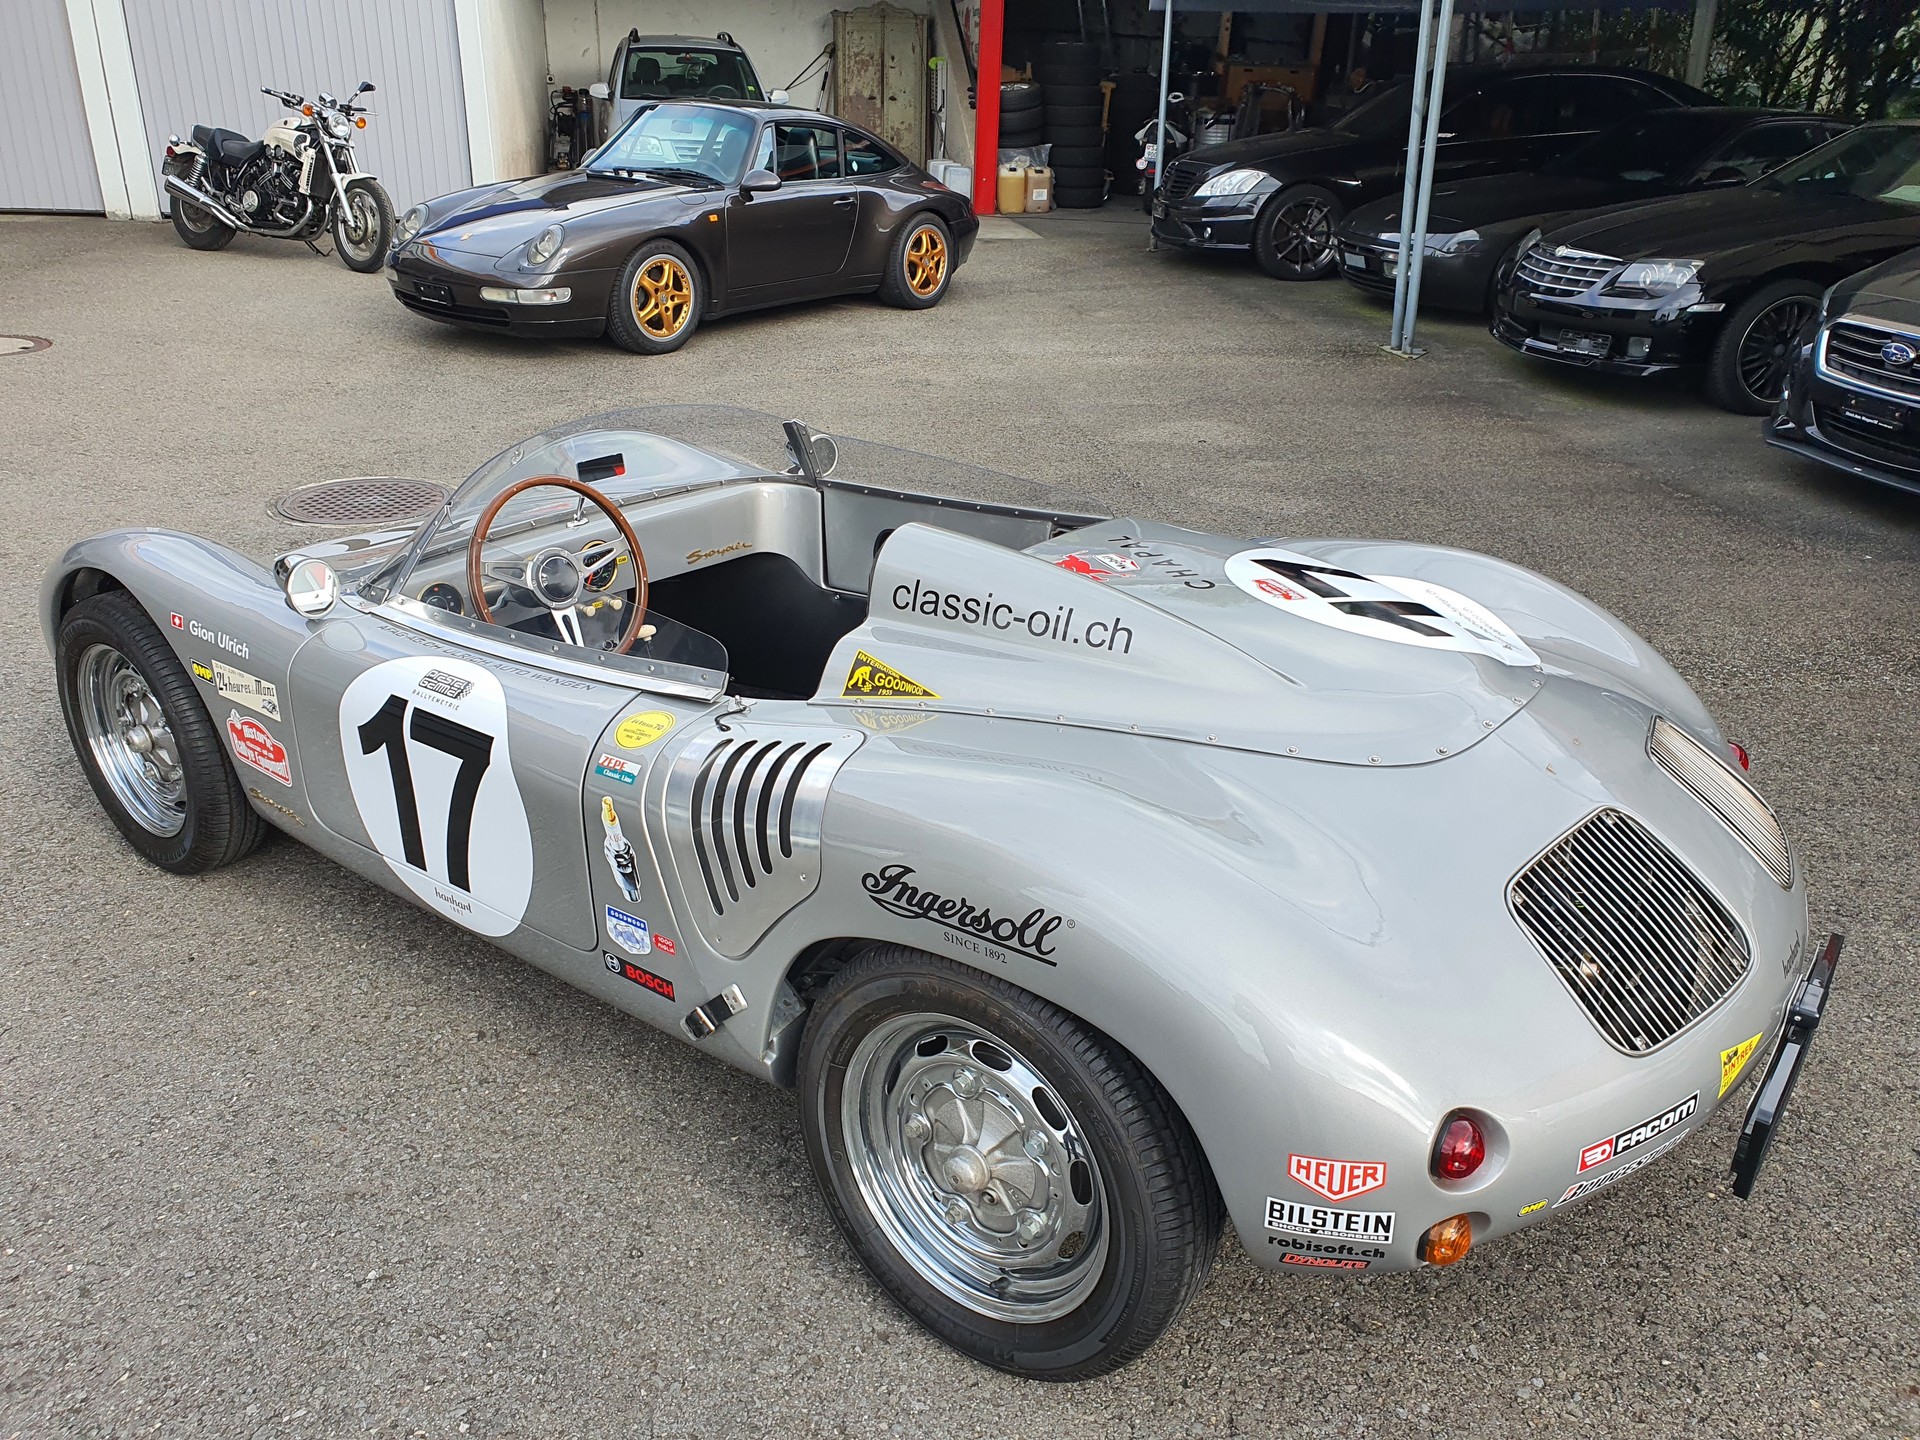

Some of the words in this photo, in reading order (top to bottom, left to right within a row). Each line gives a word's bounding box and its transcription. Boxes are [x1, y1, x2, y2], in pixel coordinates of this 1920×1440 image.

[1108, 535, 1216, 590] CHAPAL
[892, 579, 1133, 654] classic-oil.ch
[189, 620, 215, 644] Gion
[218, 631, 249, 660] Ulrich
[192, 662, 213, 681] OMP
[443, 648, 490, 666] ULRICH
[492, 663, 532, 677] AUTO
[532, 671, 598, 692] WANGEN
[857, 653, 900, 680] INTERNATIONAL
[216, 671, 228, 692] 24
[228, 675, 252, 694] heures
[254, 679, 275, 697] Mans
[875, 672, 924, 696] GOODWOOD
[412, 689, 460, 711] RALLYEMETRIE
[603, 768, 621, 780] Classic
[621, 773, 633, 784] Line
[357, 693, 495, 893] 17
[434, 886, 473, 914] hanhart
[861, 864, 1062, 955] Ingersoll
[610, 909, 645, 929] GOODWOOD
[657, 936, 673, 947] 1000
[943, 931, 980, 954] SINCE
[983, 946, 1007, 964] 1892
[625, 964, 674, 998] BOSCH
[1722, 1039, 1755, 1078] AINTREE
[1616, 1099, 1696, 1153] FACOM
[1295, 1158, 1380, 1196] HEUER
[1268, 1199, 1392, 1234] BILSTEIN
[1520, 1200, 1547, 1215] OMP
[1271, 1220, 1312, 1233] SHOCK
[1316, 1229, 1387, 1241] ABSORBERS
[1268, 1235, 1386, 1259] robisoft.ch
[1281, 1253, 1367, 1269] DYNOLITE
